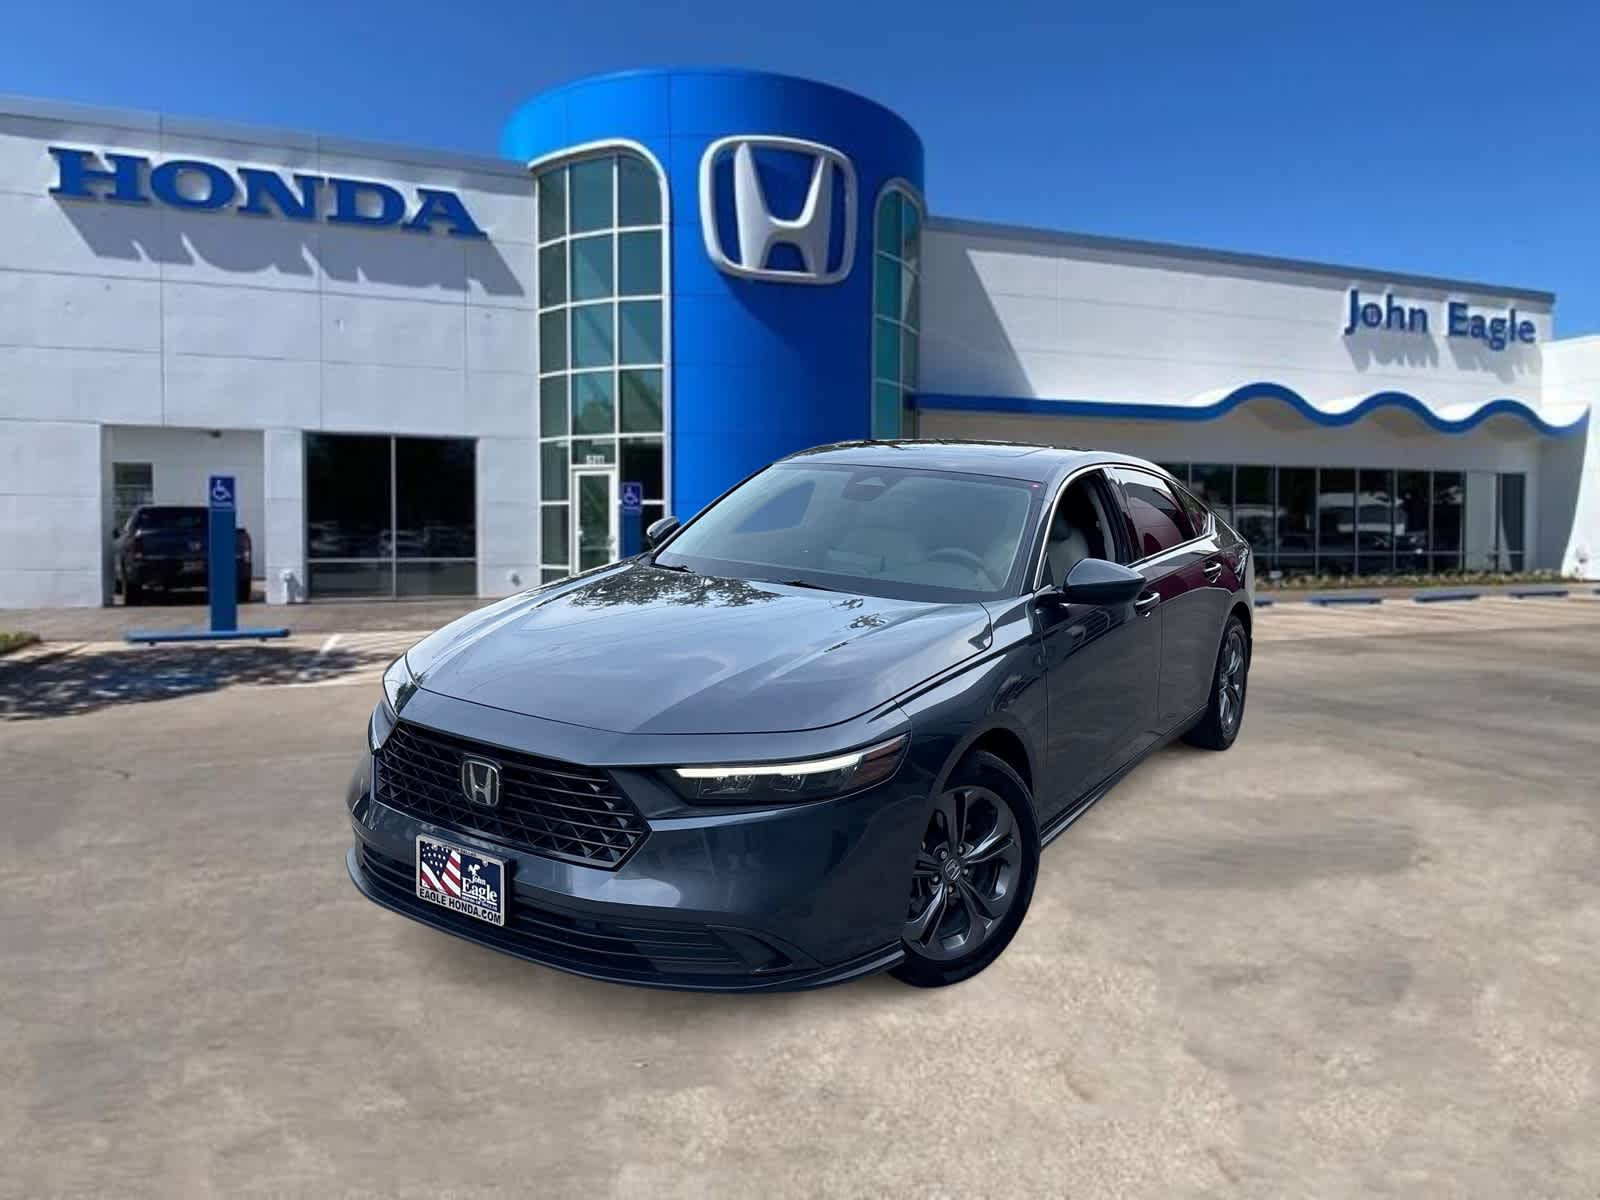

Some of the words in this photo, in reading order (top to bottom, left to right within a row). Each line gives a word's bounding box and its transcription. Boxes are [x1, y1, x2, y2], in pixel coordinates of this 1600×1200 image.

[48, 146, 488, 240] HONDA
[1344, 288, 1428, 336] John
[1447, 301, 1536, 351] Eagle
[420, 887, 447, 905] EAGLE
[448, 899, 501, 923] HONDA.COM
[462, 876, 498, 902] Eagle
